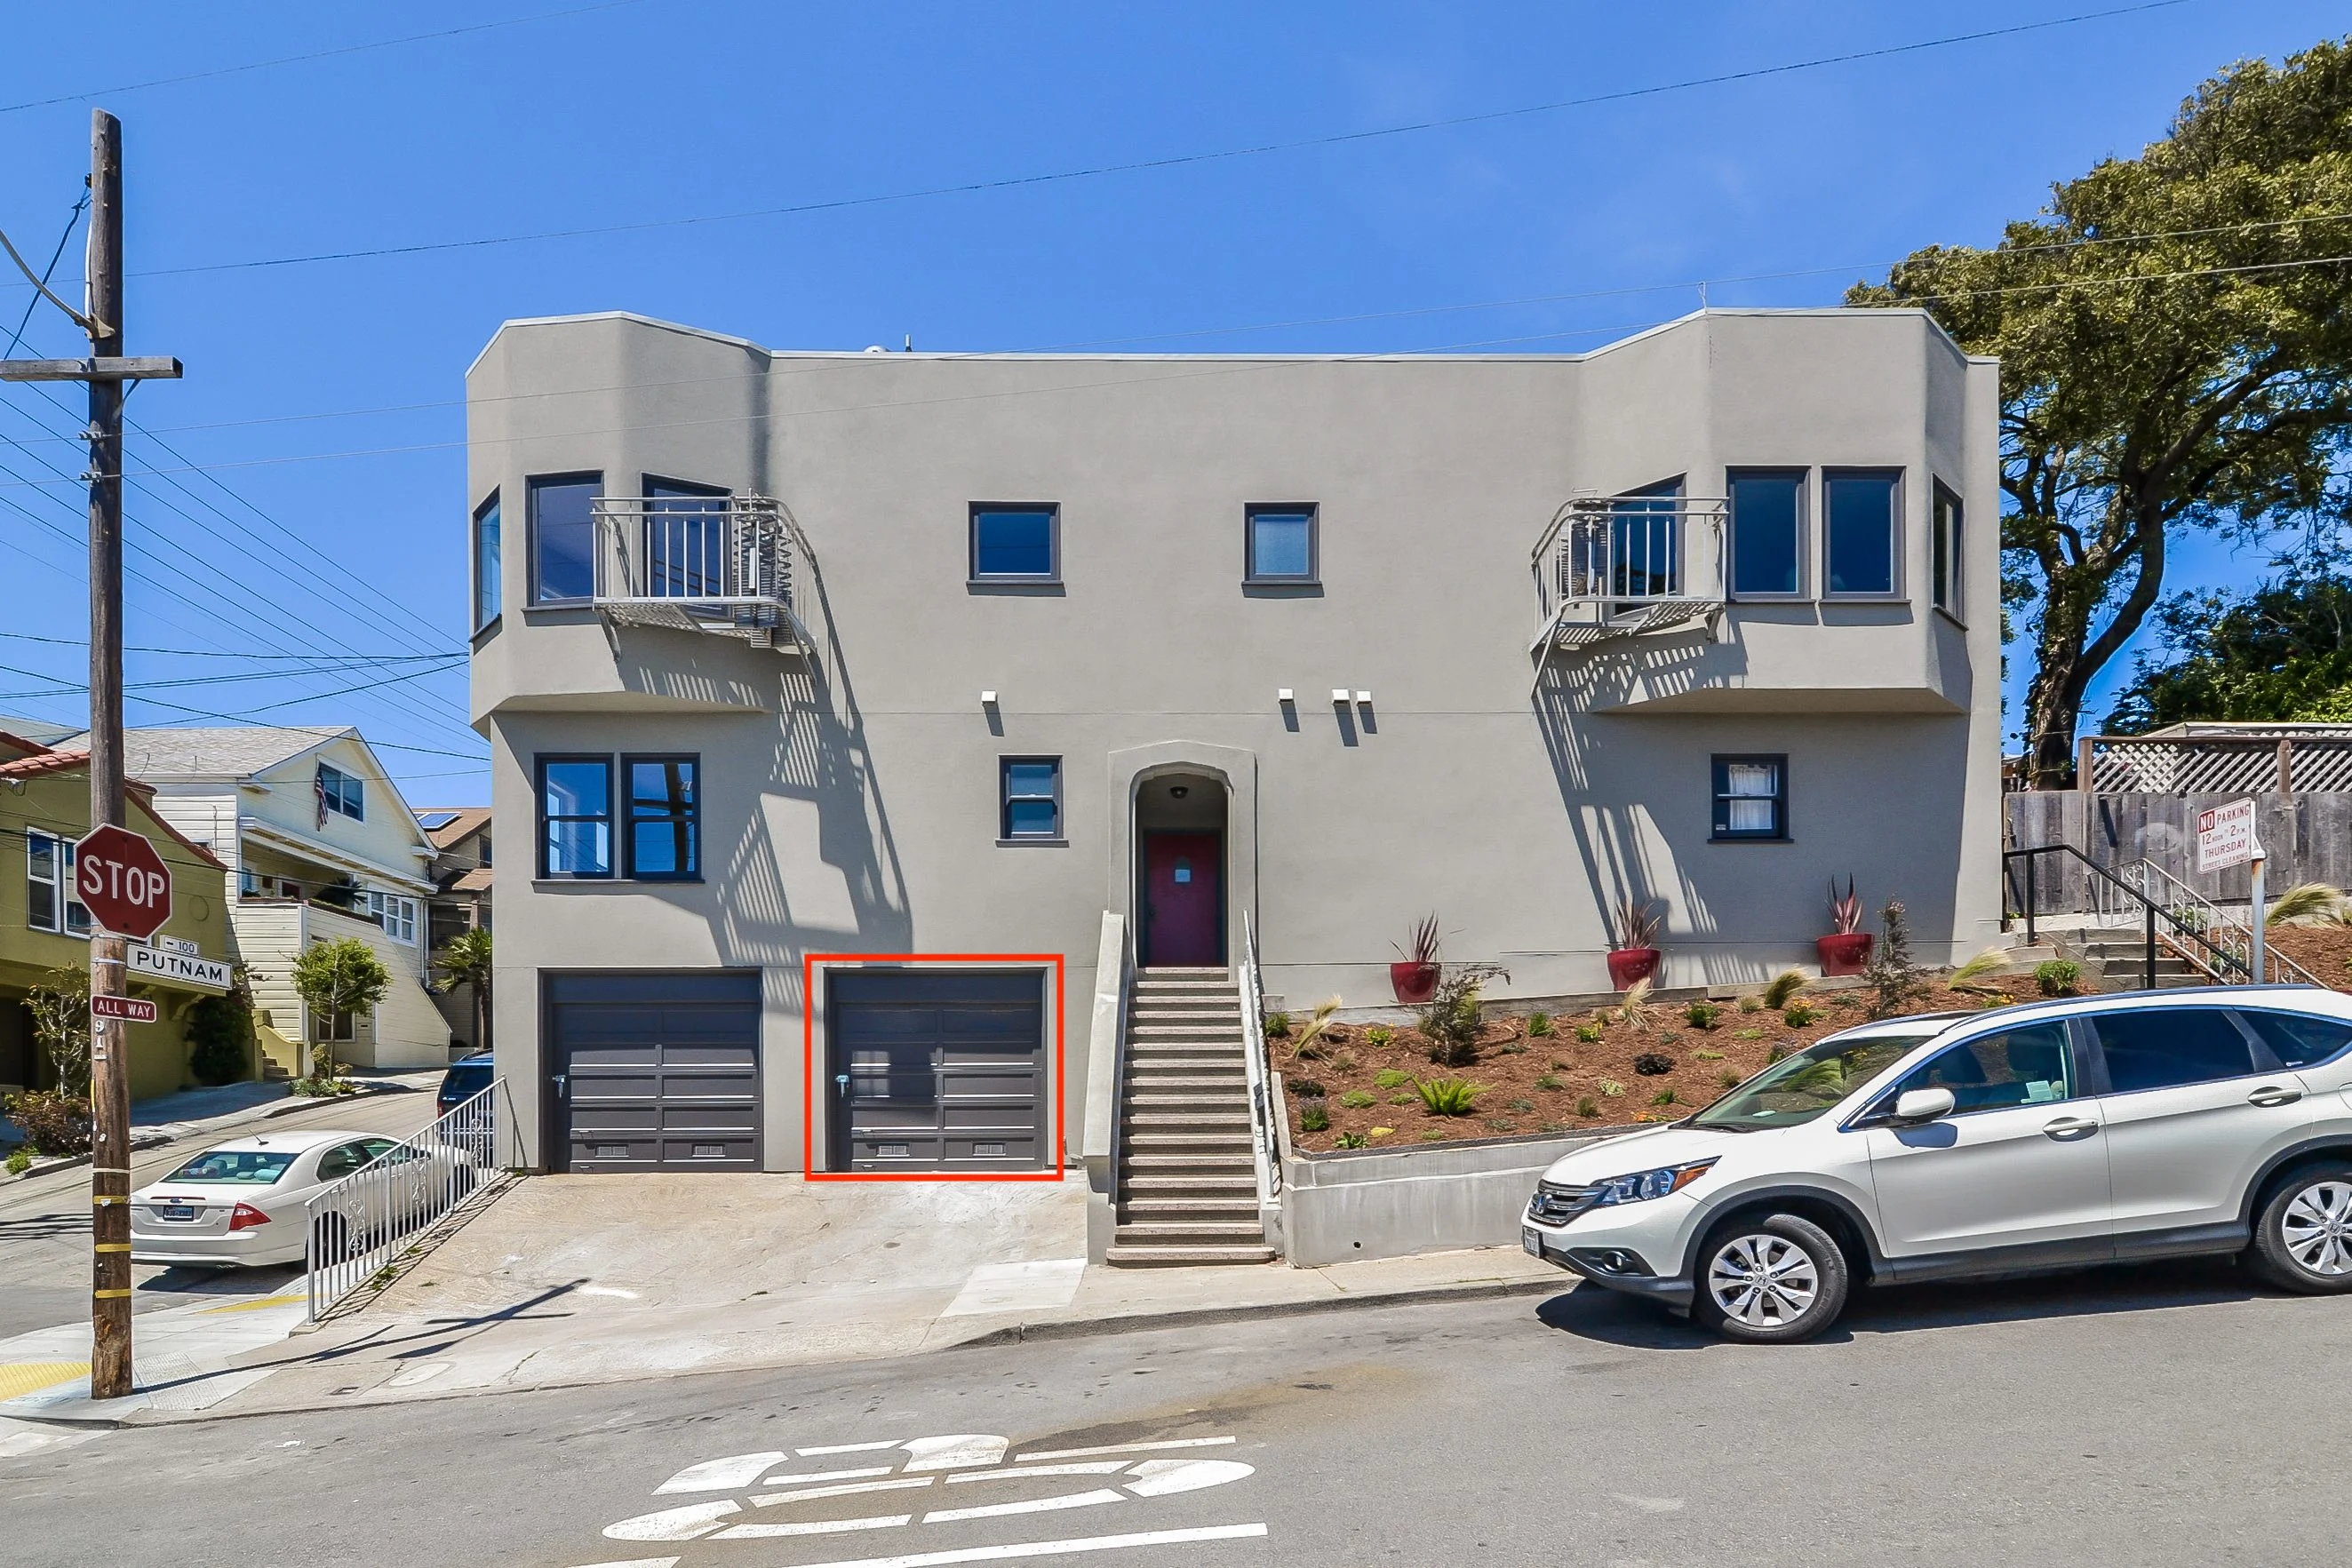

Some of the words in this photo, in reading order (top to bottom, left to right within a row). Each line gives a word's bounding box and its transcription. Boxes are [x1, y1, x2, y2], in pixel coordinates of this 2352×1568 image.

[2200, 813, 2213, 832] NO
[2217, 804, 2250, 824] PARKING
[2202, 833, 2212, 845] 12
[2230, 825, 2236, 836] 2
[2205, 839, 2246, 858] THURSDAY
[83, 855, 164, 908] STOP
[179, 942, 195, 952] 100
[137, 951, 222, 981] PUTNAM
[98, 1000, 121, 1014] ALL
[128, 1003, 150, 1017] WAY
